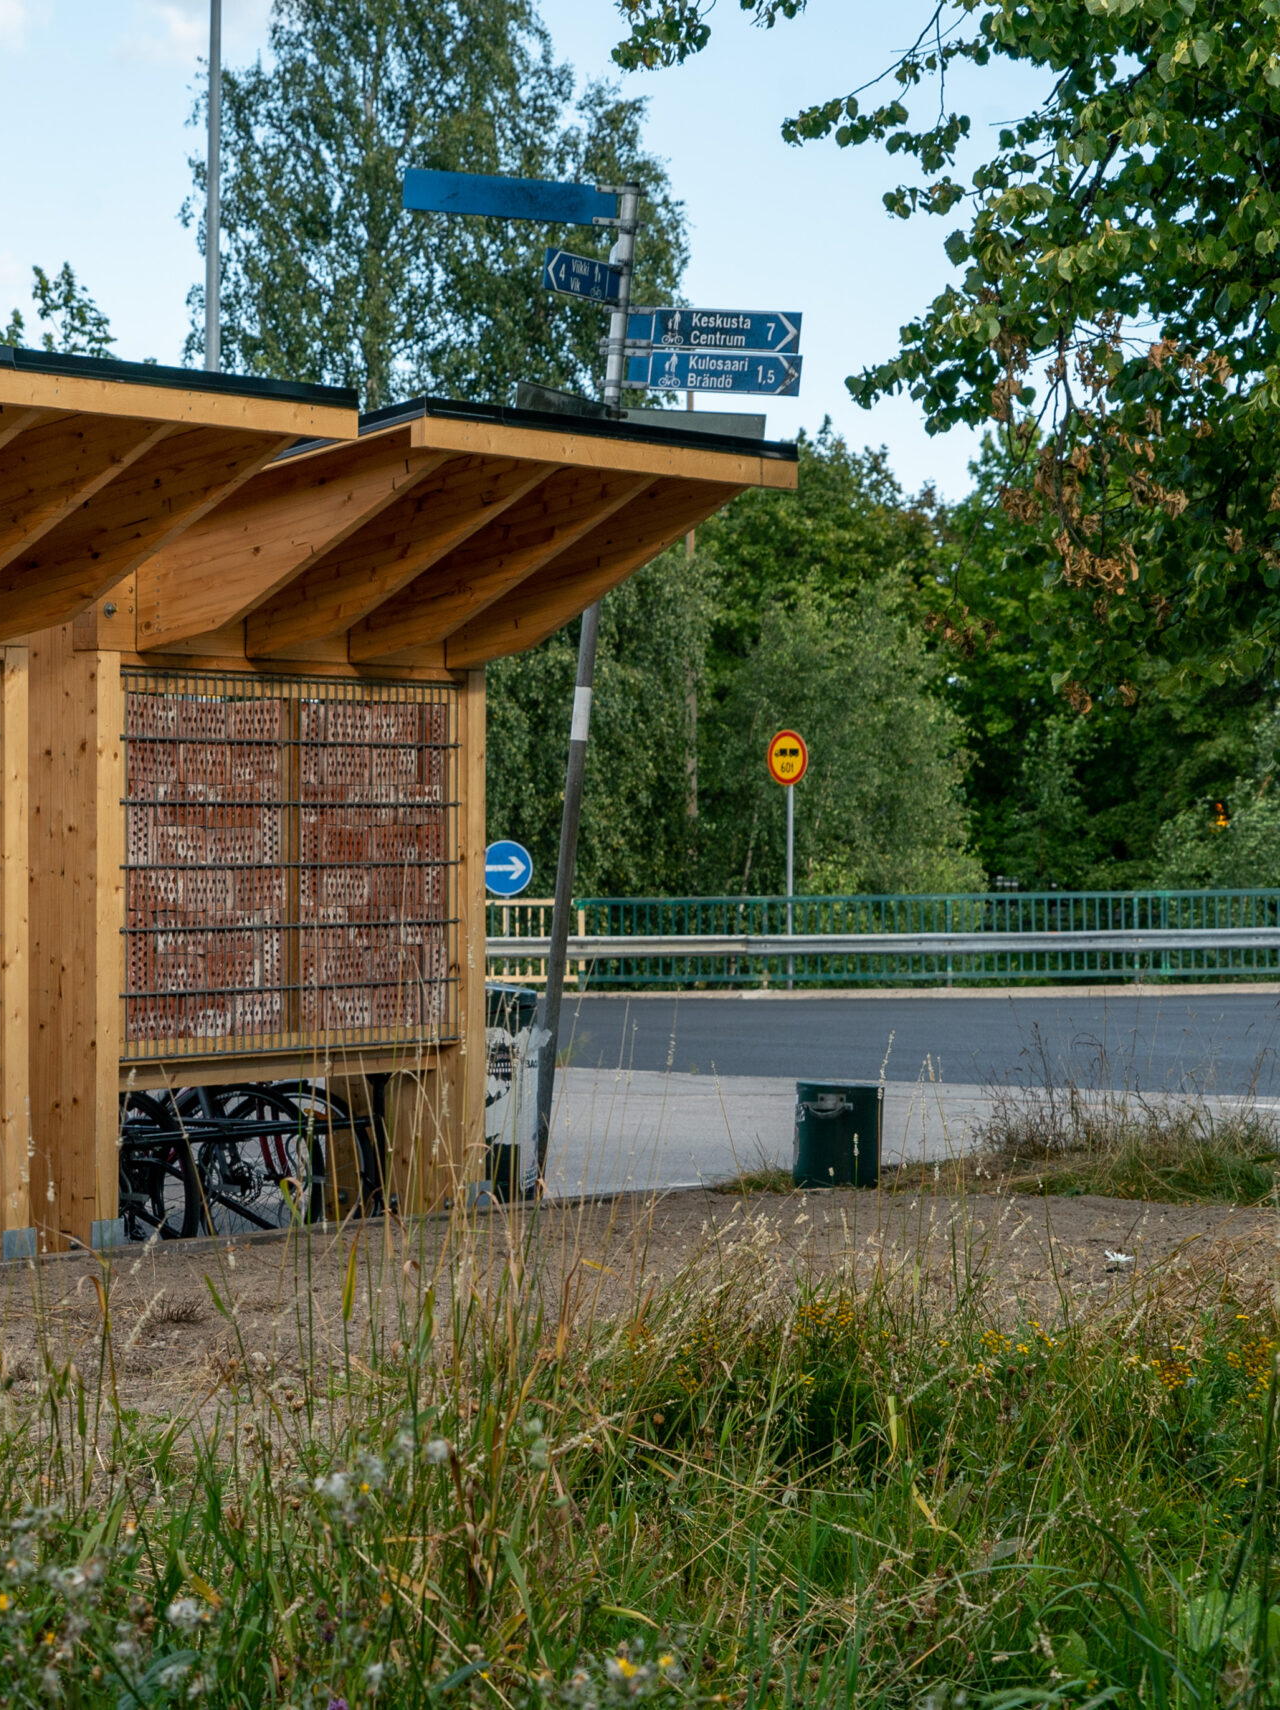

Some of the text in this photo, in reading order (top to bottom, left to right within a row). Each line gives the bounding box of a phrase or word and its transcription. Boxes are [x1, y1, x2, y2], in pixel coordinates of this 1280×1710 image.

[559, 263, 566, 281] 4
[570, 277, 581, 293] Vik
[692, 312, 776, 342] Keskusta 7
[690, 330, 746, 347] Centrum
[688, 355, 776, 385] Kulosaari 1,5
[687, 372, 733, 389] Brändö
[781, 762, 794, 773] 601
